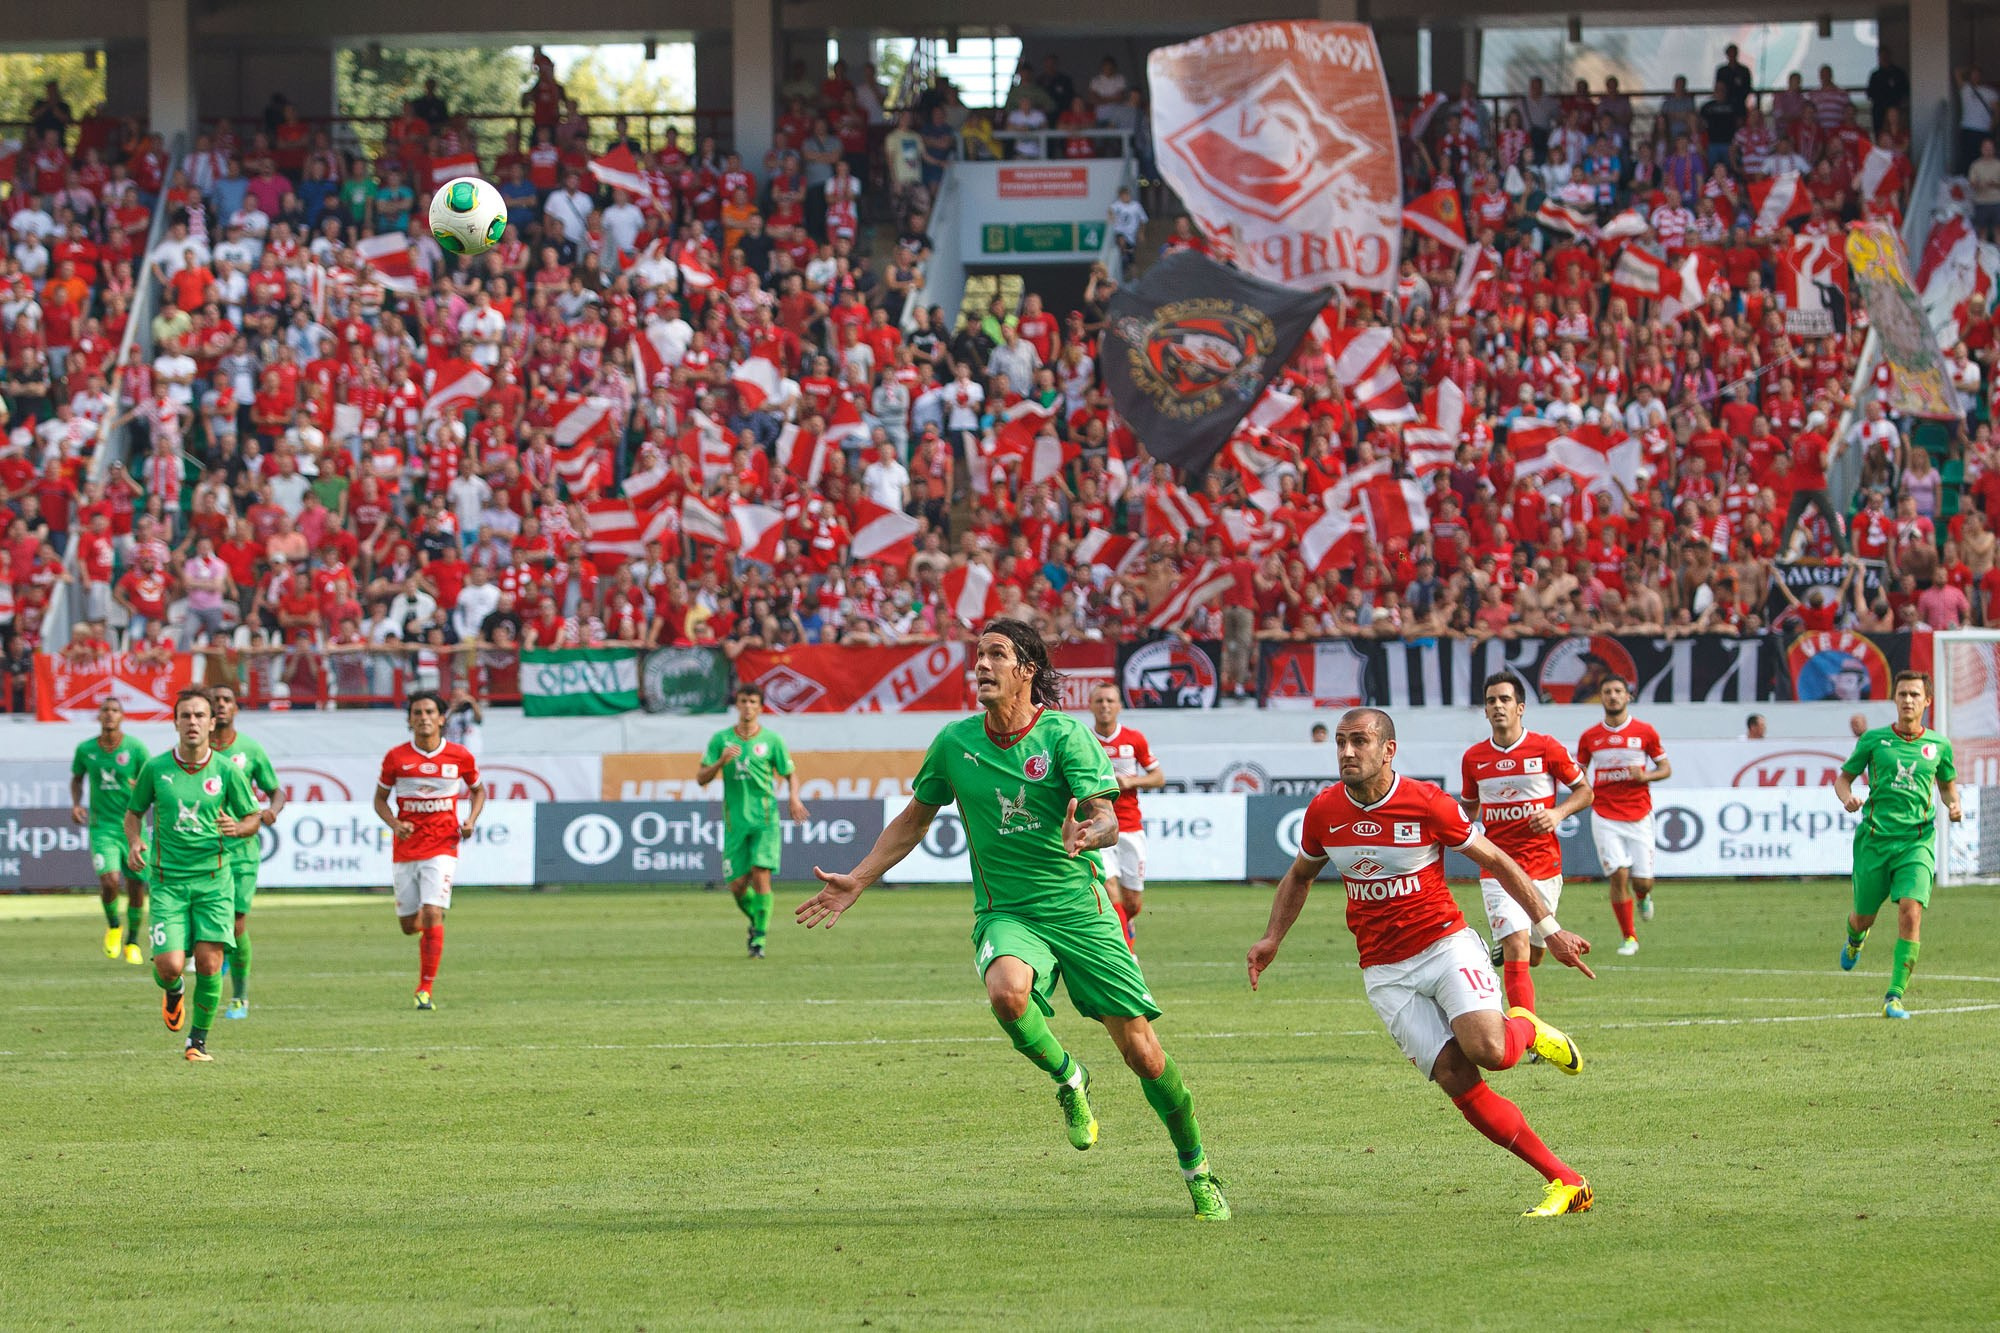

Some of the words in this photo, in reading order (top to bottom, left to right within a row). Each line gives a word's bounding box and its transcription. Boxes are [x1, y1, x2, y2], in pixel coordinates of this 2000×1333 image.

[632, 848, 705, 871] Банк
[1719, 838, 1793, 860] Банк
[292, 851, 361, 873] Банк
